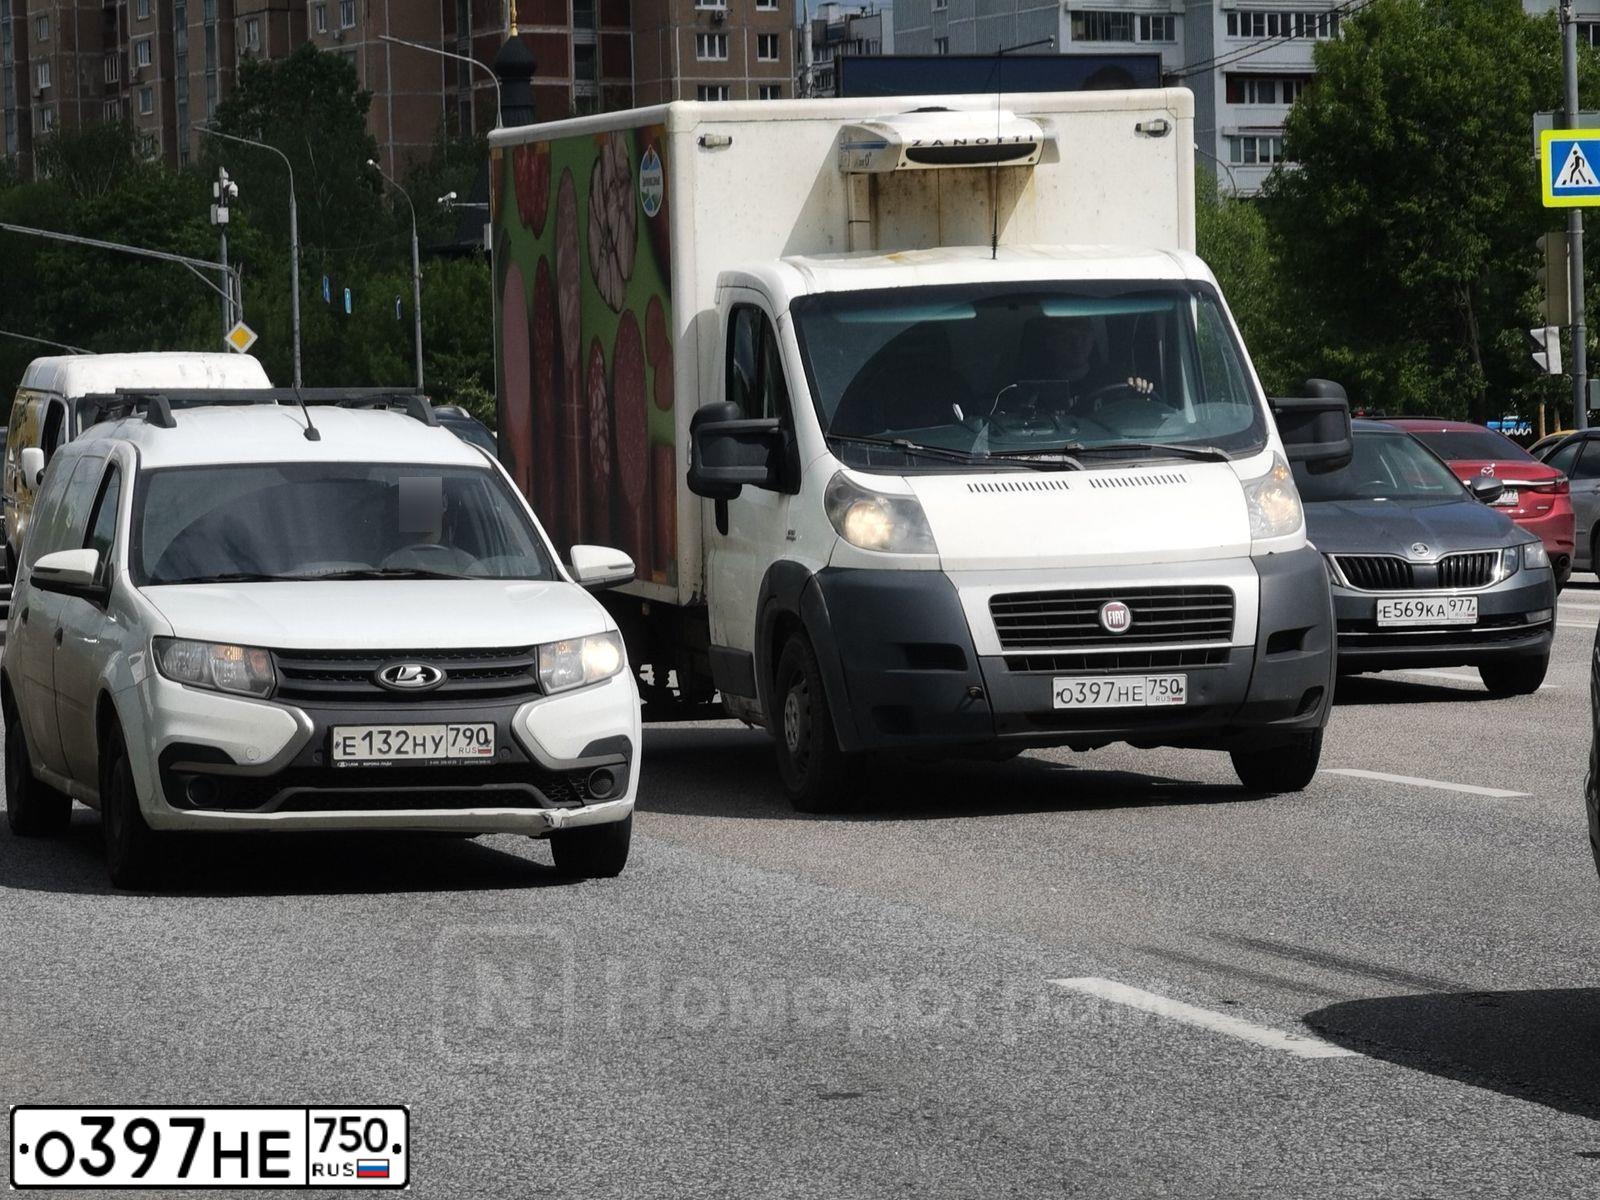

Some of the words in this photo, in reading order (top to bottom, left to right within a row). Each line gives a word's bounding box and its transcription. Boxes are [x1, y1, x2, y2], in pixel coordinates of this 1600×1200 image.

[912, 135, 1034, 147] ZANOTTI
[1383, 601, 1446, 618] Е569КА
[1449, 599, 1473, 611] 977
[1107, 610, 1124, 625] FIAT
[1060, 681, 1143, 704] О397НЕ
[1148, 679, 1180, 696] 750
[342, 730, 444, 756] Е132НУ
[449, 727, 487, 747] 790
[458, 746, 477, 754] RUS
